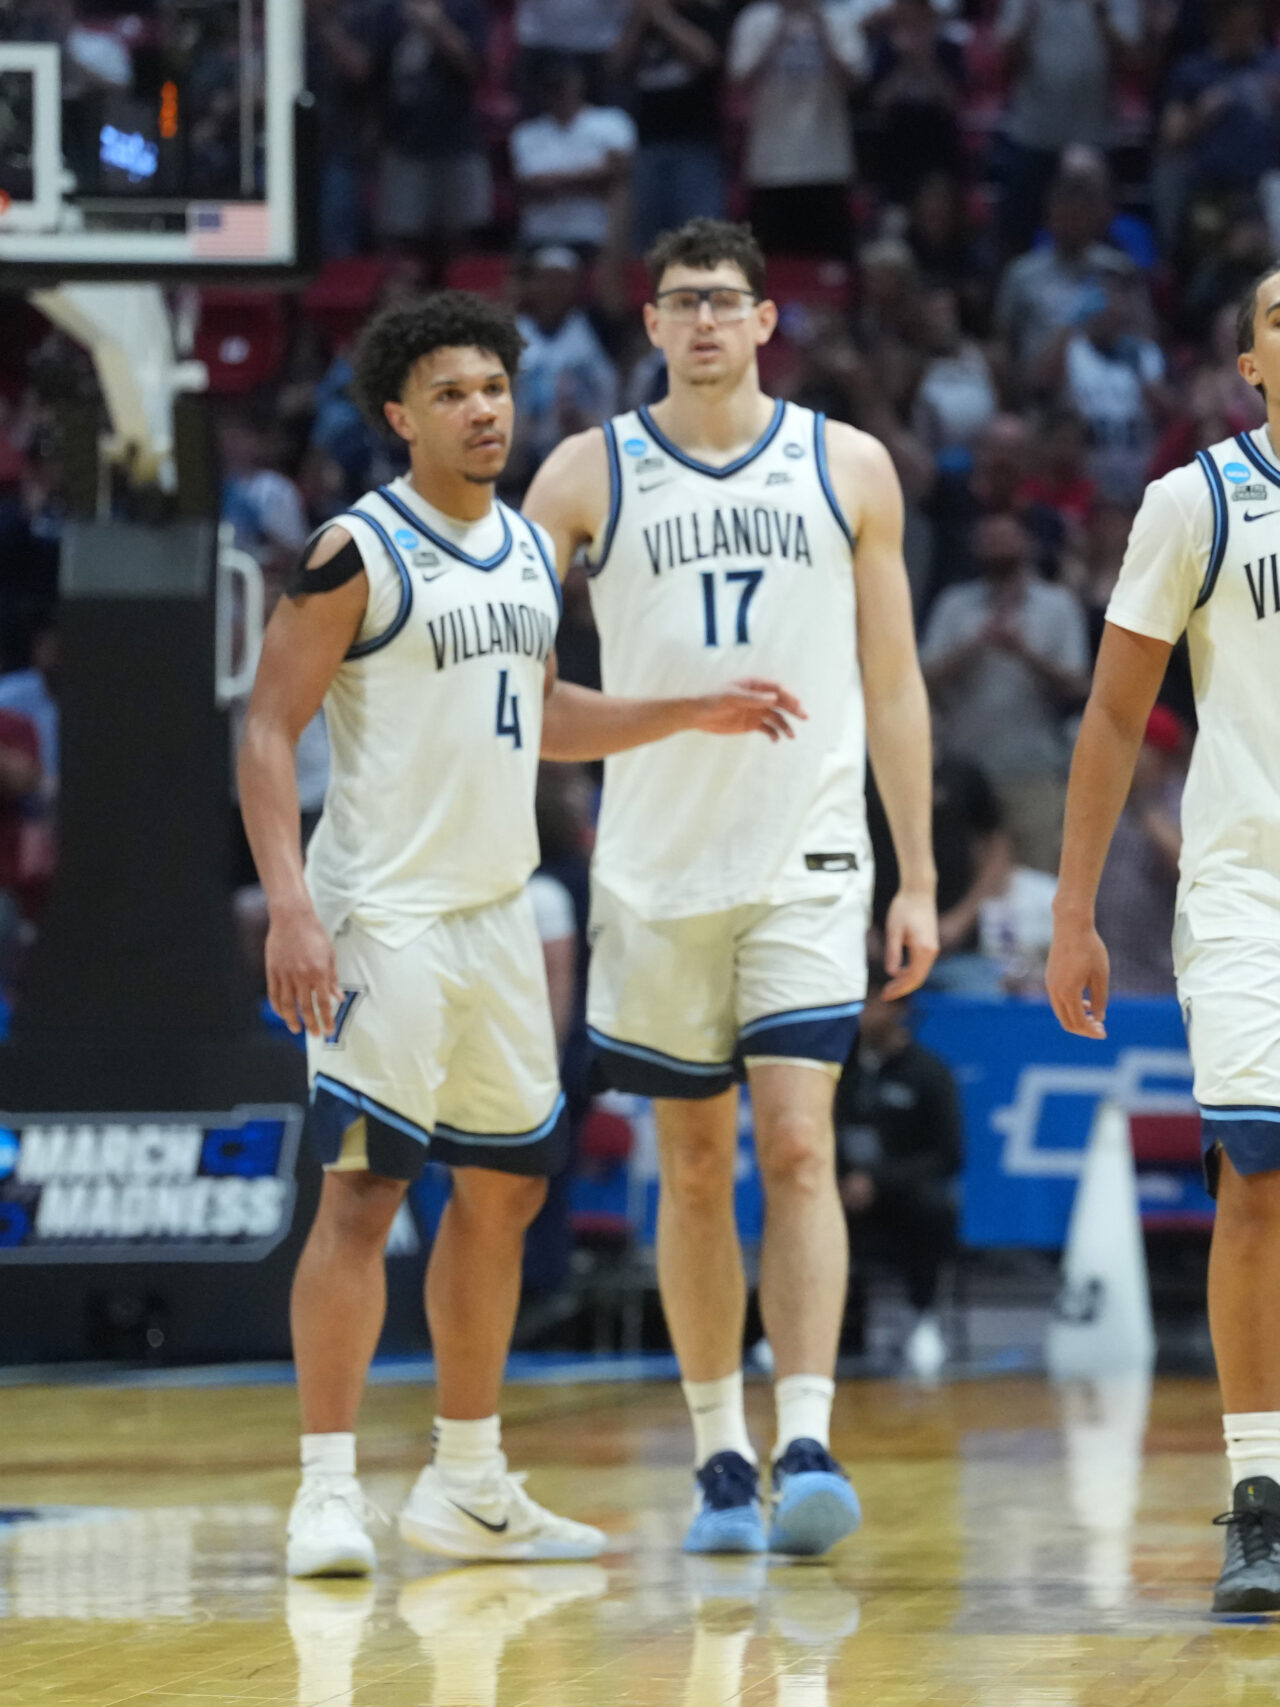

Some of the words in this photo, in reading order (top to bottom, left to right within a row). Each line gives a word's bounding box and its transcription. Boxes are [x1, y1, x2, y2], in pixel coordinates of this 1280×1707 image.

[643, 506, 813, 576] VILLANOVA
[700, 569, 765, 648] 17
[496, 669, 522, 749] 4
[19, 1124, 203, 1184] MARCH
[36, 1176, 288, 1238] MADNESS
